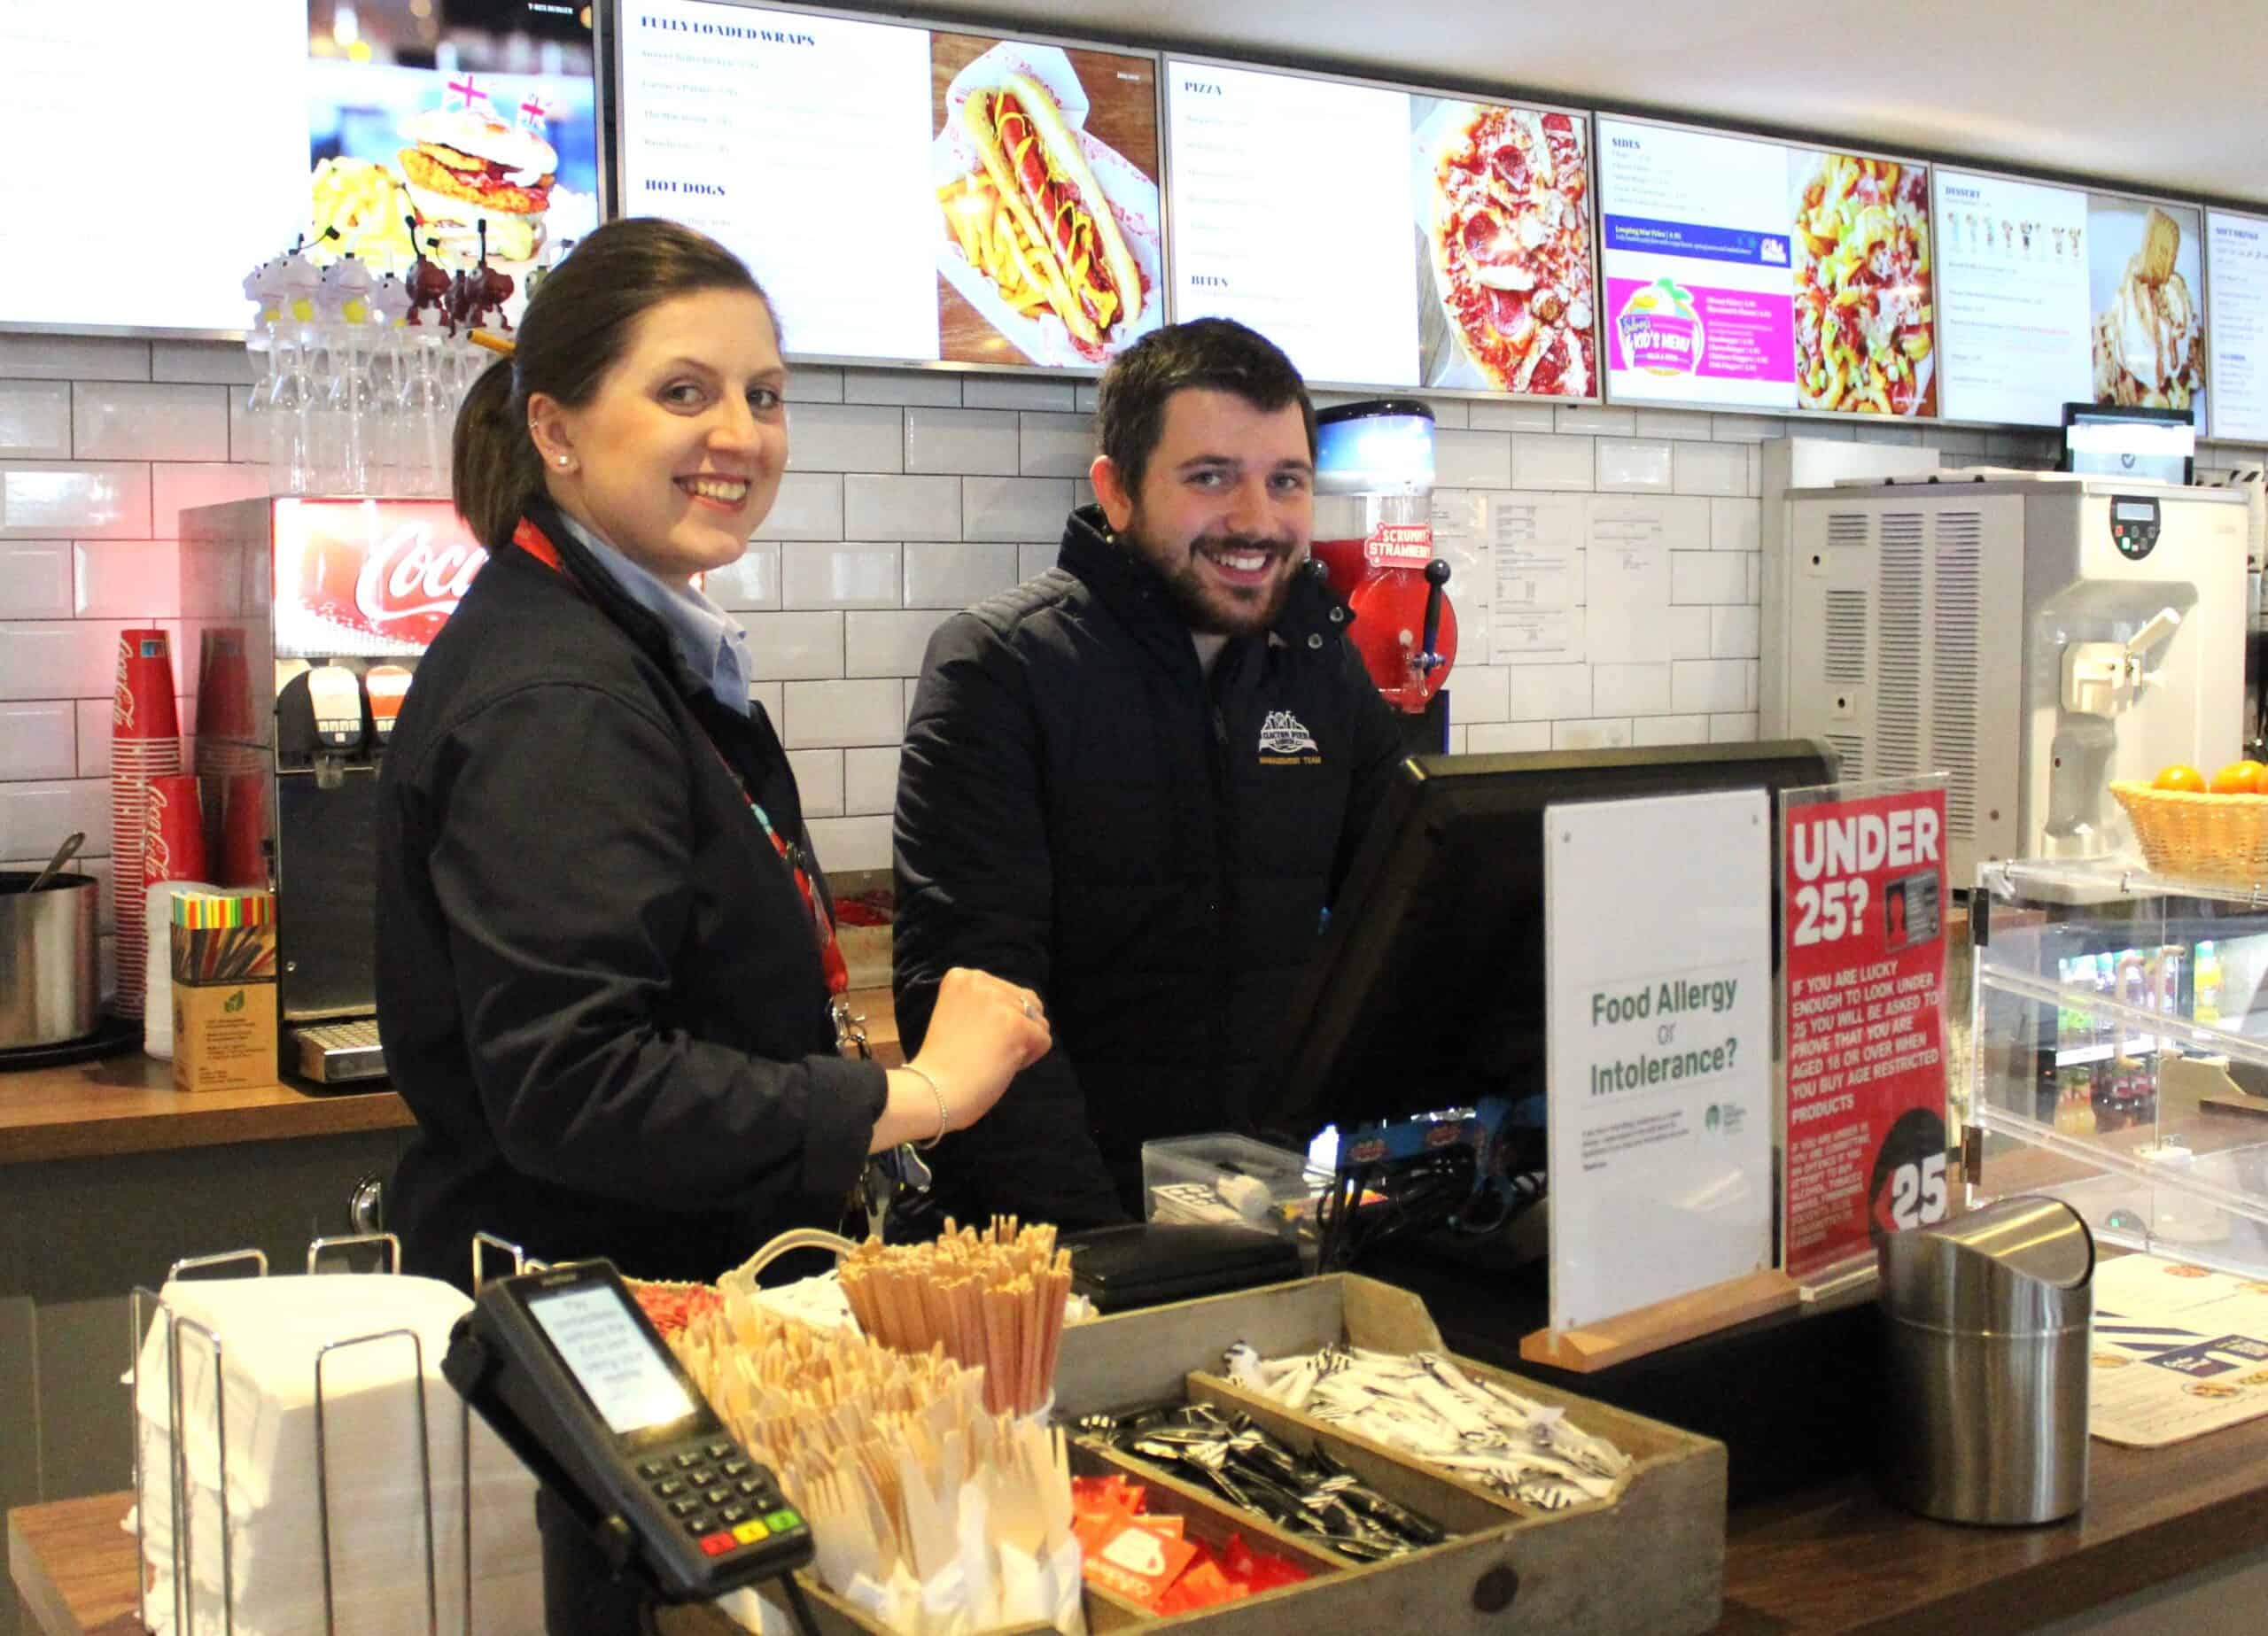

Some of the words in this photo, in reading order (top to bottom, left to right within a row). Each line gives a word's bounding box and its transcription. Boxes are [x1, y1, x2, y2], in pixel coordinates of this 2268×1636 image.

[641, 15, 688, 33] FULLY
[693, 21, 757, 40] LOADED
[760, 27, 816, 47] WRAPS
[1184, 81, 1222, 96] PIZZA
[1612, 137, 1641, 150] SIDES
[644, 179, 678, 192] HOT
[682, 182, 726, 197] DOGS
[1945, 185, 1981, 199] DESSERT
[1192, 275, 1228, 288] BITES
[1793, 807, 1940, 881] UNDER
[1794, 877, 1869, 946] 25?
[1792, 980, 1803, 996] IF
[1807, 974, 1831, 993] YOU
[1835, 968, 1858, 987] ARE
[1860, 960, 1899, 982] LUCKY
[1792, 992, 1843, 1018] ENOUGH
[1845, 989, 1861, 1004] TO
[1864, 982, 1894, 1001] LOOK
[1897, 972, 1934, 993] UNDER
[1592, 986, 1651, 1027] Food
[1657, 979, 1737, 1016] Allergy
[1792, 1021, 1806, 1039] 25
[1811, 1015, 1835, 1033] YOU
[1837, 1008, 1864, 1027] WILL
[1867, 1004, 1883, 1020] BE
[1885, 995, 1922, 1015] ASKED
[1924, 990, 1940, 1007] TO
[1658, 1022, 1676, 1045] or
[1792, 1036, 1830, 1059] PROVE
[1834, 1027, 1862, 1049] THAT
[1866, 1021, 1890, 1040] YOU
[1891, 1015, 1914, 1034] ARE
[1792, 1058, 1823, 1080] AGED
[1844, 1049, 1860, 1066] OR
[1862, 1040, 1892, 1061] OVER
[1895, 1030, 1927, 1053] WHEN
[1591, 1037, 1737, 1097] Intolerance?
[1792, 1081, 1816, 1100] YOU
[1820, 1072, 1844, 1093] BUY
[1848, 1066, 1871, 1086] AGE
[1873, 1048, 1939, 1079] RESTRICTED
[1792, 1093, 1854, 1124] PRODUCTS
[1891, 1152, 1946, 1232] 25
